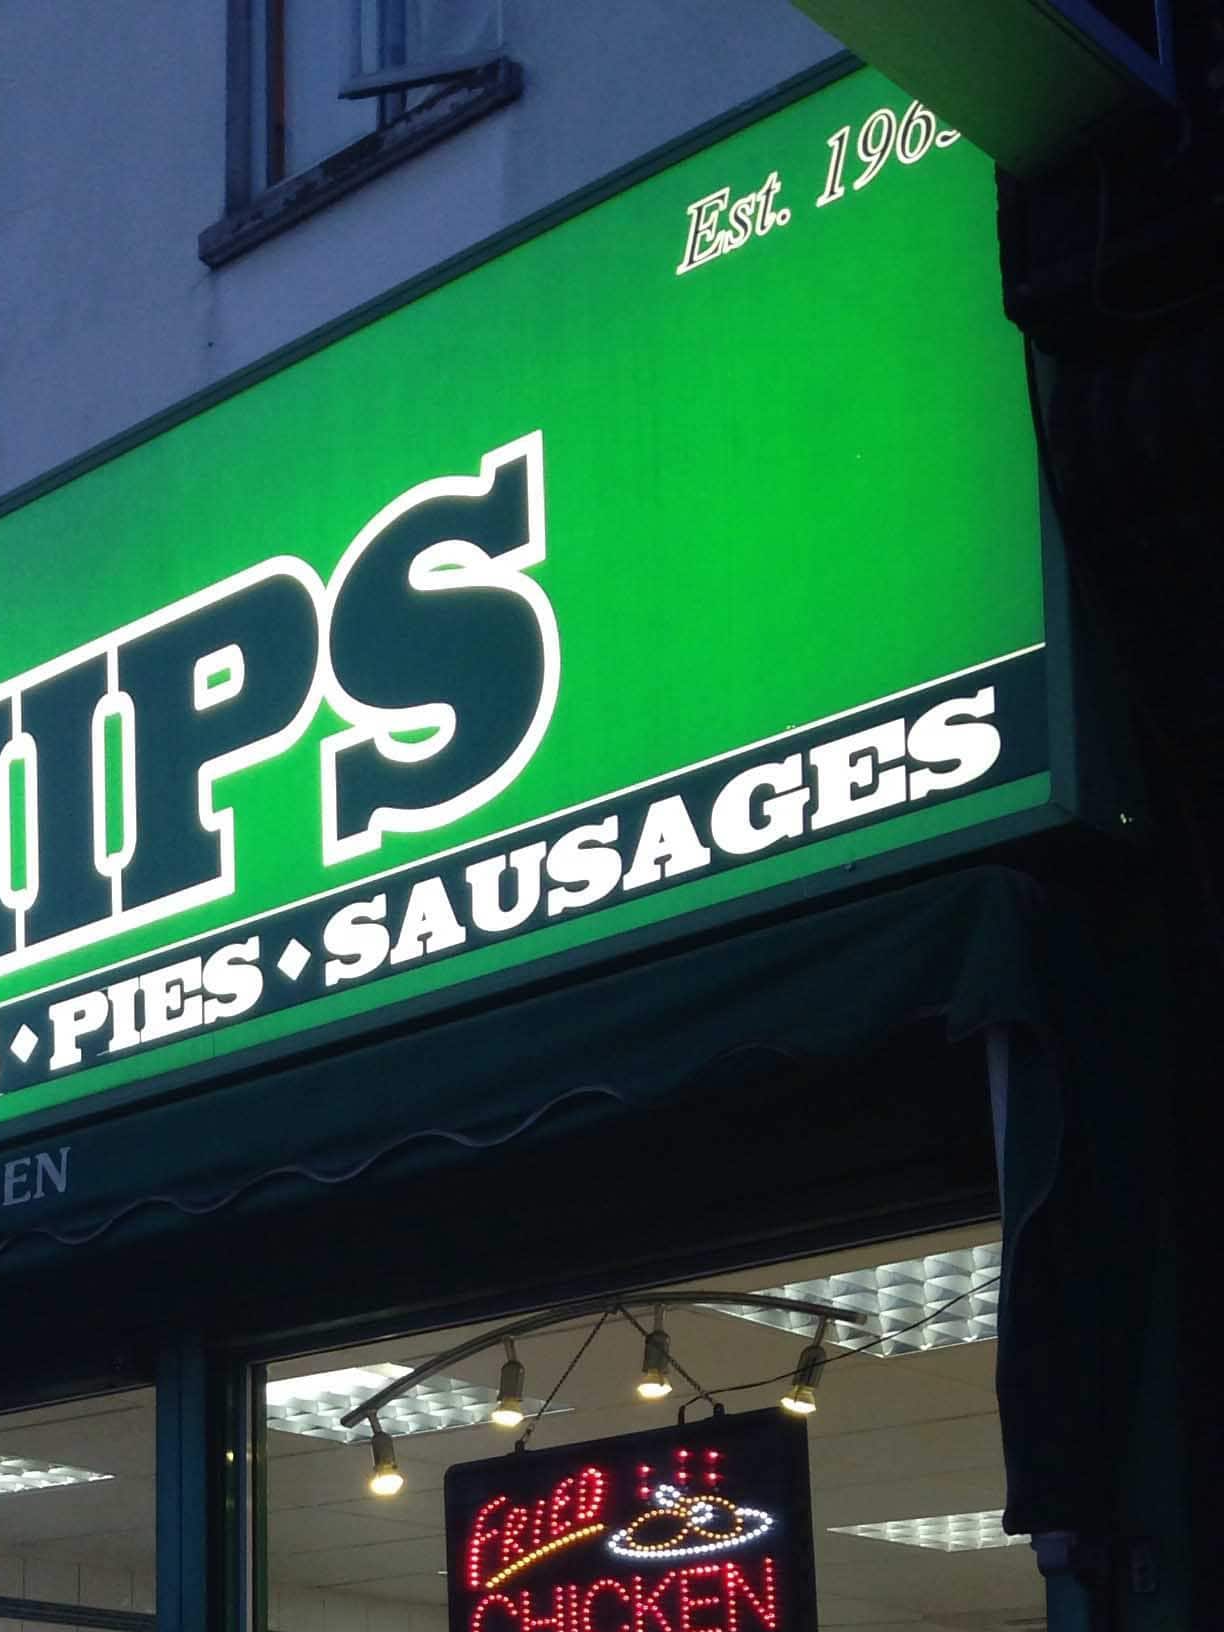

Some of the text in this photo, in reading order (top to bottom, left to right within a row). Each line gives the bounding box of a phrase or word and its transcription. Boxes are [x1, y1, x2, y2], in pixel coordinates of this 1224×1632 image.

[676, 99, 961, 276] Est. 196
[48, 935, 265, 1072] PIES
[322, 685, 1002, 986] SAUSAGES
